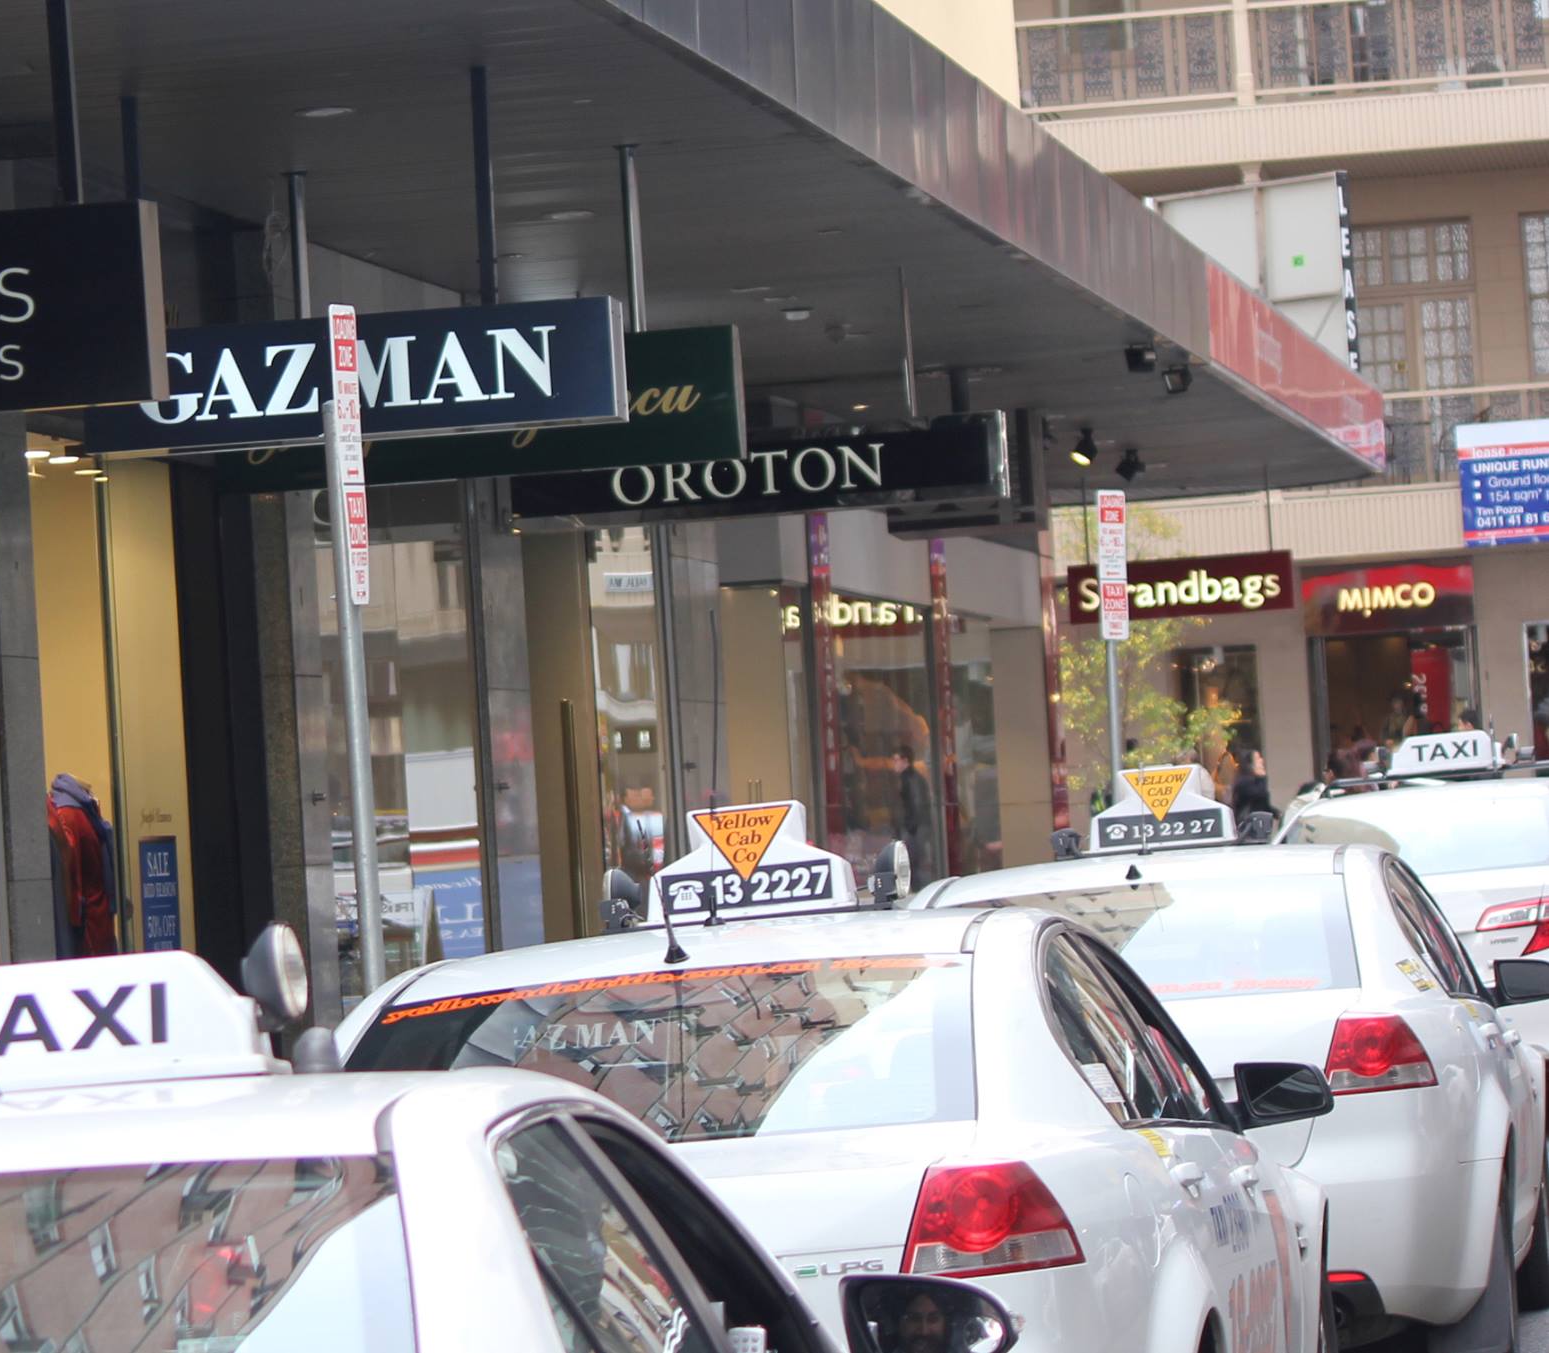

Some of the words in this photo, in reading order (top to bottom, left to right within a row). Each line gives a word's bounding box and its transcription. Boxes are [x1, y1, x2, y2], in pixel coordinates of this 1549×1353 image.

[1336, 186, 1360, 370] LEASE
[336, 345, 354, 369] ZONE
[612, 442, 885, 505] OROTON
[1473, 460, 1520, 475] UNIQUE
[1488, 474, 1532, 489] Ground
[1489, 490, 1511, 503] 154
[347, 496, 364, 519] TAXI
[1477, 516, 1505, 529] 0411
[1508, 513, 1522, 526] 41
[1525, 511, 1539, 525] 81
[350, 523, 367, 546] ZONE
[1079, 570, 1281, 613] Srandbags
[1104, 584, 1124, 597] TAXI
[1104, 599, 1126, 612] ZONE
[1411, 739, 1479, 763] TAXI
[1135, 772, 1186, 786] YELLOW
[1148, 786, 1173, 797] CAB
[1151, 798, 1169, 808] CO
[714, 813, 774, 831] Yellow
[1132, 823, 1155, 839] 13
[1159, 821, 1185, 836] 22
[1190, 818, 1215, 834] 27
[726, 832, 762, 847] Cab
[146, 851, 171, 877] SALE
[733, 848, 758, 864] Co
[710, 872, 744, 905] 13
[750, 864, 830, 902] 2227
[162, 914, 177, 937] OFF
